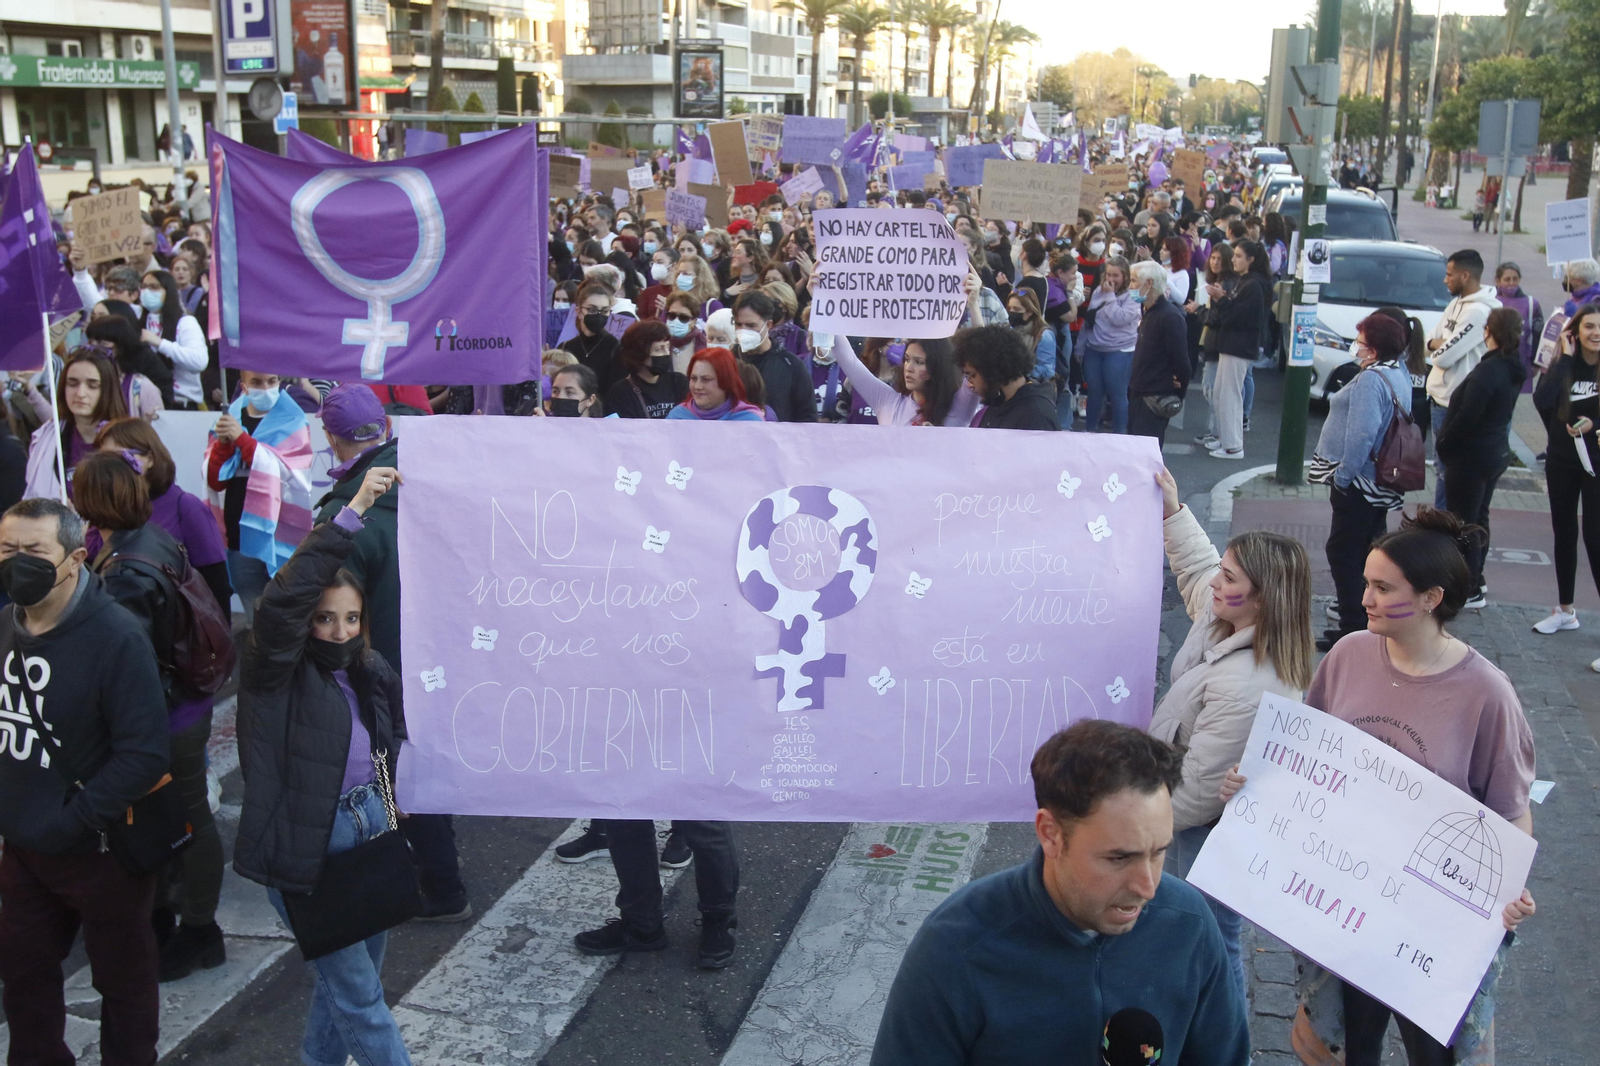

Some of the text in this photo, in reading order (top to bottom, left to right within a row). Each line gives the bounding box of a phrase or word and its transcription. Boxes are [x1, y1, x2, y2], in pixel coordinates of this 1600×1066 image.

[232, 0, 264, 38] P
[37, 58, 115, 83] Fraternidad
[668, 203, 694, 219] LIBRES
[669, 192, 701, 209] JUNTAS
[819, 220, 955, 240] NO HAY CARTEL TAN
[821, 246, 957, 266] GRANDE COMO PARA
[819, 272, 961, 294] REGISTRAR TODO POR
[815, 299, 965, 321] LO QUE PROTESTAMOS
[456, 336, 513, 351] CÓRDOBA
[646, 402, 675, 411] ONCEPT
[491, 489, 578, 560] NO
[934, 491, 1043, 547] porque
[771, 516, 840, 562] SOMOS
[793, 553, 826, 580] 8M
[954, 539, 1074, 590] nuestra
[468, 539, 701, 623] necesitamos
[1001, 573, 1116, 626] mente
[518, 631, 691, 674] que nos
[932, 624, 1045, 669] está en
[784, 716, 810, 730] IES
[1351, 715, 1427, 754] YTHOLOGICAL FEELINGS
[773, 733, 816, 745] GALILEO
[773, 745, 812, 755] GALILEI
[777, 761, 838, 774] PROMOCIÓN
[1318, 728, 1344, 759] HA
[1354, 748, 1424, 801] SALIDO
[761, 778, 835, 788] DE IGUALDAD DE
[1292, 790, 1327, 823] NO,
[1234, 795, 1405, 905] OS HE SALIDO DE
[1439, 858, 1474, 892] libres
[1248, 853, 1367, 933] LA JAULA!!
